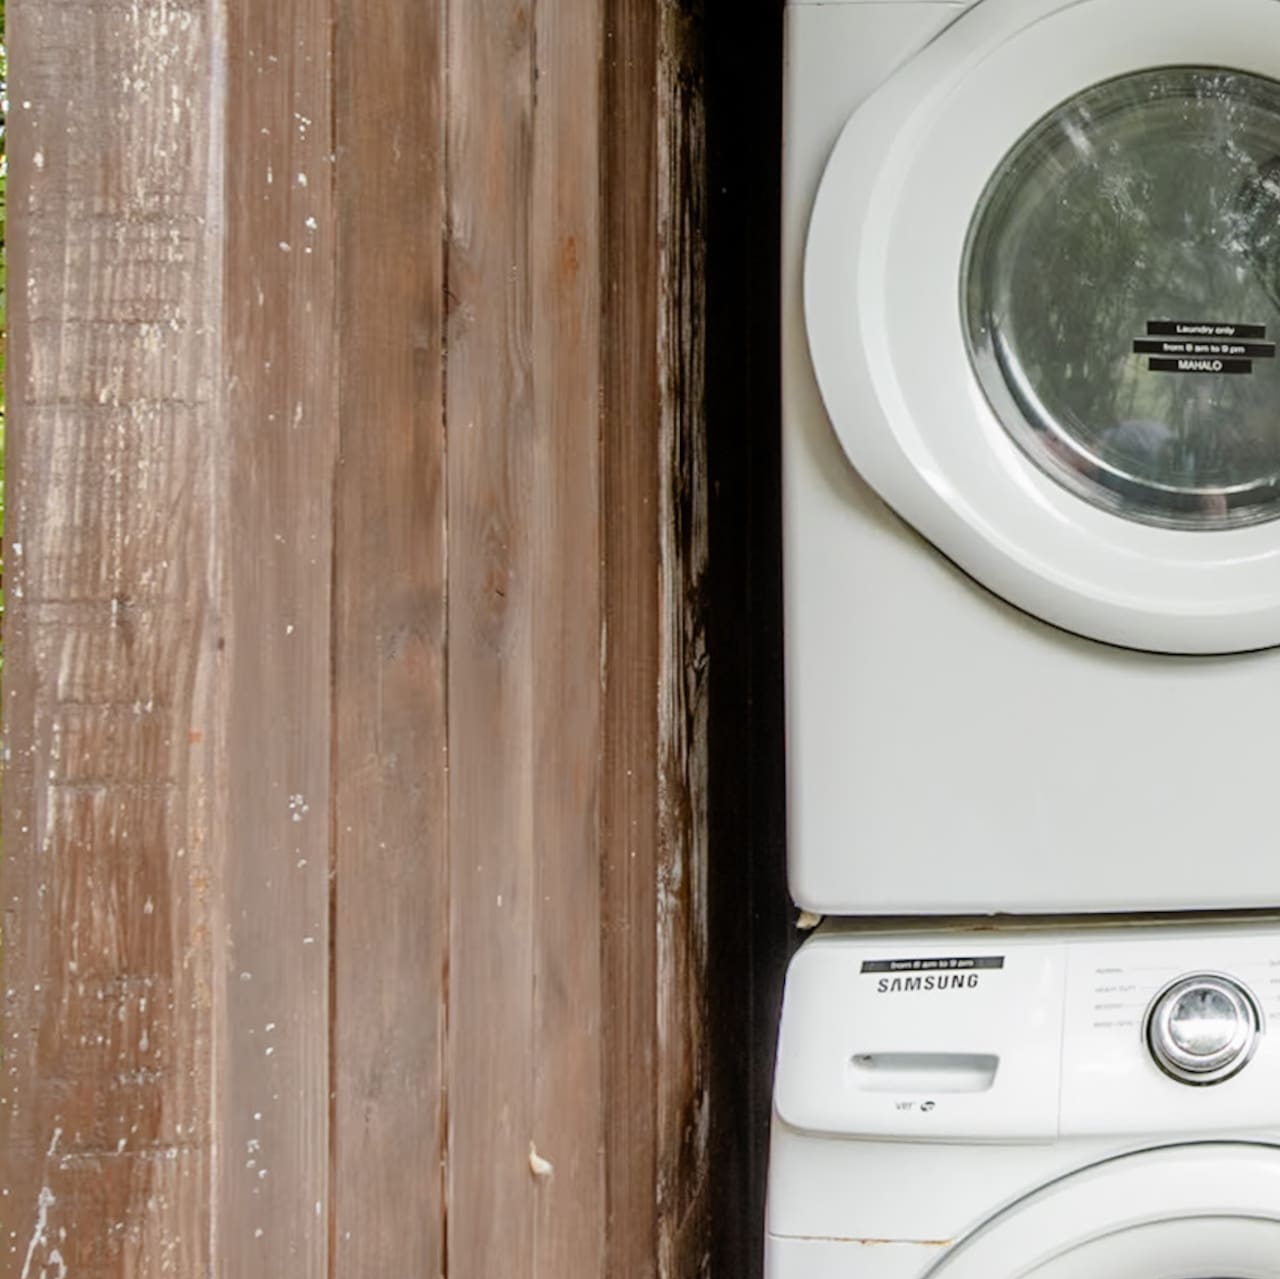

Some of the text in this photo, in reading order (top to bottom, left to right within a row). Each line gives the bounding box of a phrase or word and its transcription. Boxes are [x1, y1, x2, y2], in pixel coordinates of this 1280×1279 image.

[1176, 324, 1235, 336] Laundry only
[1163, 343, 1184, 352] from
[1195, 344, 1209, 353] am
[1210, 344, 1220, 353] to
[1221, 344, 1229, 353] 9
[1230, 346, 1245, 355] pm
[1178, 360, 1222, 371] MAHALO
[877, 974, 979, 993] SAMSUNG
